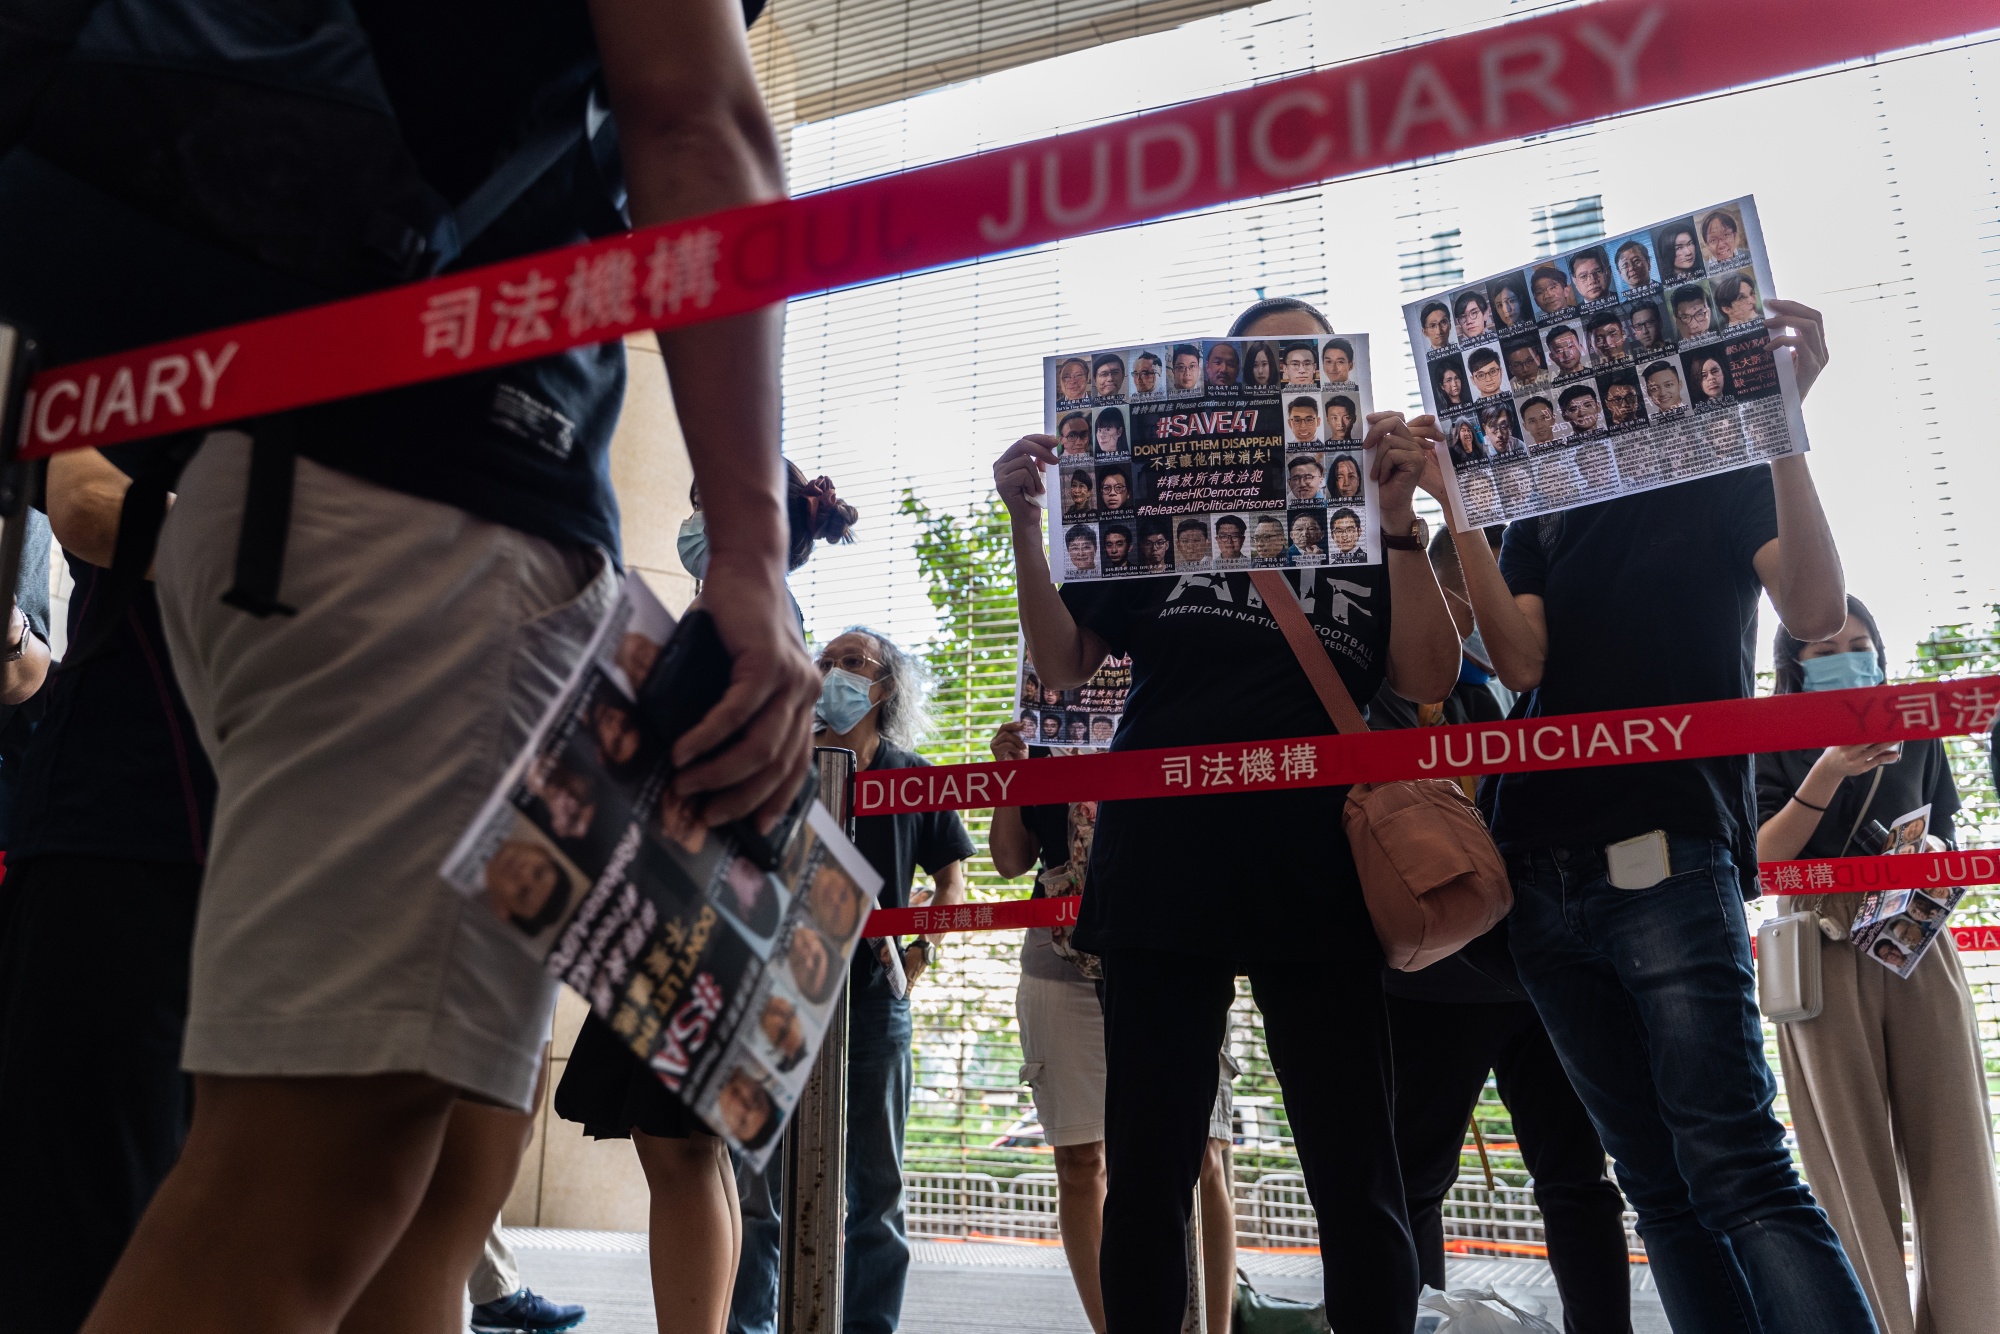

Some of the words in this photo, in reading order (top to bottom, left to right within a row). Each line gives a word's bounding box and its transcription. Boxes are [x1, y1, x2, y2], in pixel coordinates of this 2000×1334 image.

[978, 5, 1666, 242] JUDICIARY
[419, 226, 723, 359] 司法機構
[1175, 402, 1197, 410] Please
[1198, 400, 1227, 408] continue
[1235, 400, 1248, 408] pay
[1249, 398, 1280, 406] attention
[1156, 410, 1259, 438] #SAVE47
[1134, 443, 1167, 456] DON'T
[1169, 441, 1187, 453] LET
[1189, 439, 1219, 451] THEM
[1222, 436, 1283, 449] DISAPPEAR!
[1156, 468, 1264, 488] #釋放所有政治犯
[1158, 486, 1260, 502] #FreeHKDemocrats
[1136, 498, 1285, 517] #ReleaseAllPoliticalPrisoners
[1158, 605, 1234, 619] AMERICAN
[1235, 612, 1281, 631] NATIO
[1418, 714, 1692, 771] JUDICIARY
[1161, 742, 1318, 789] 司法機構
[853, 769, 1018, 810] DICIARY
[912, 905, 994, 930] 司法機構
